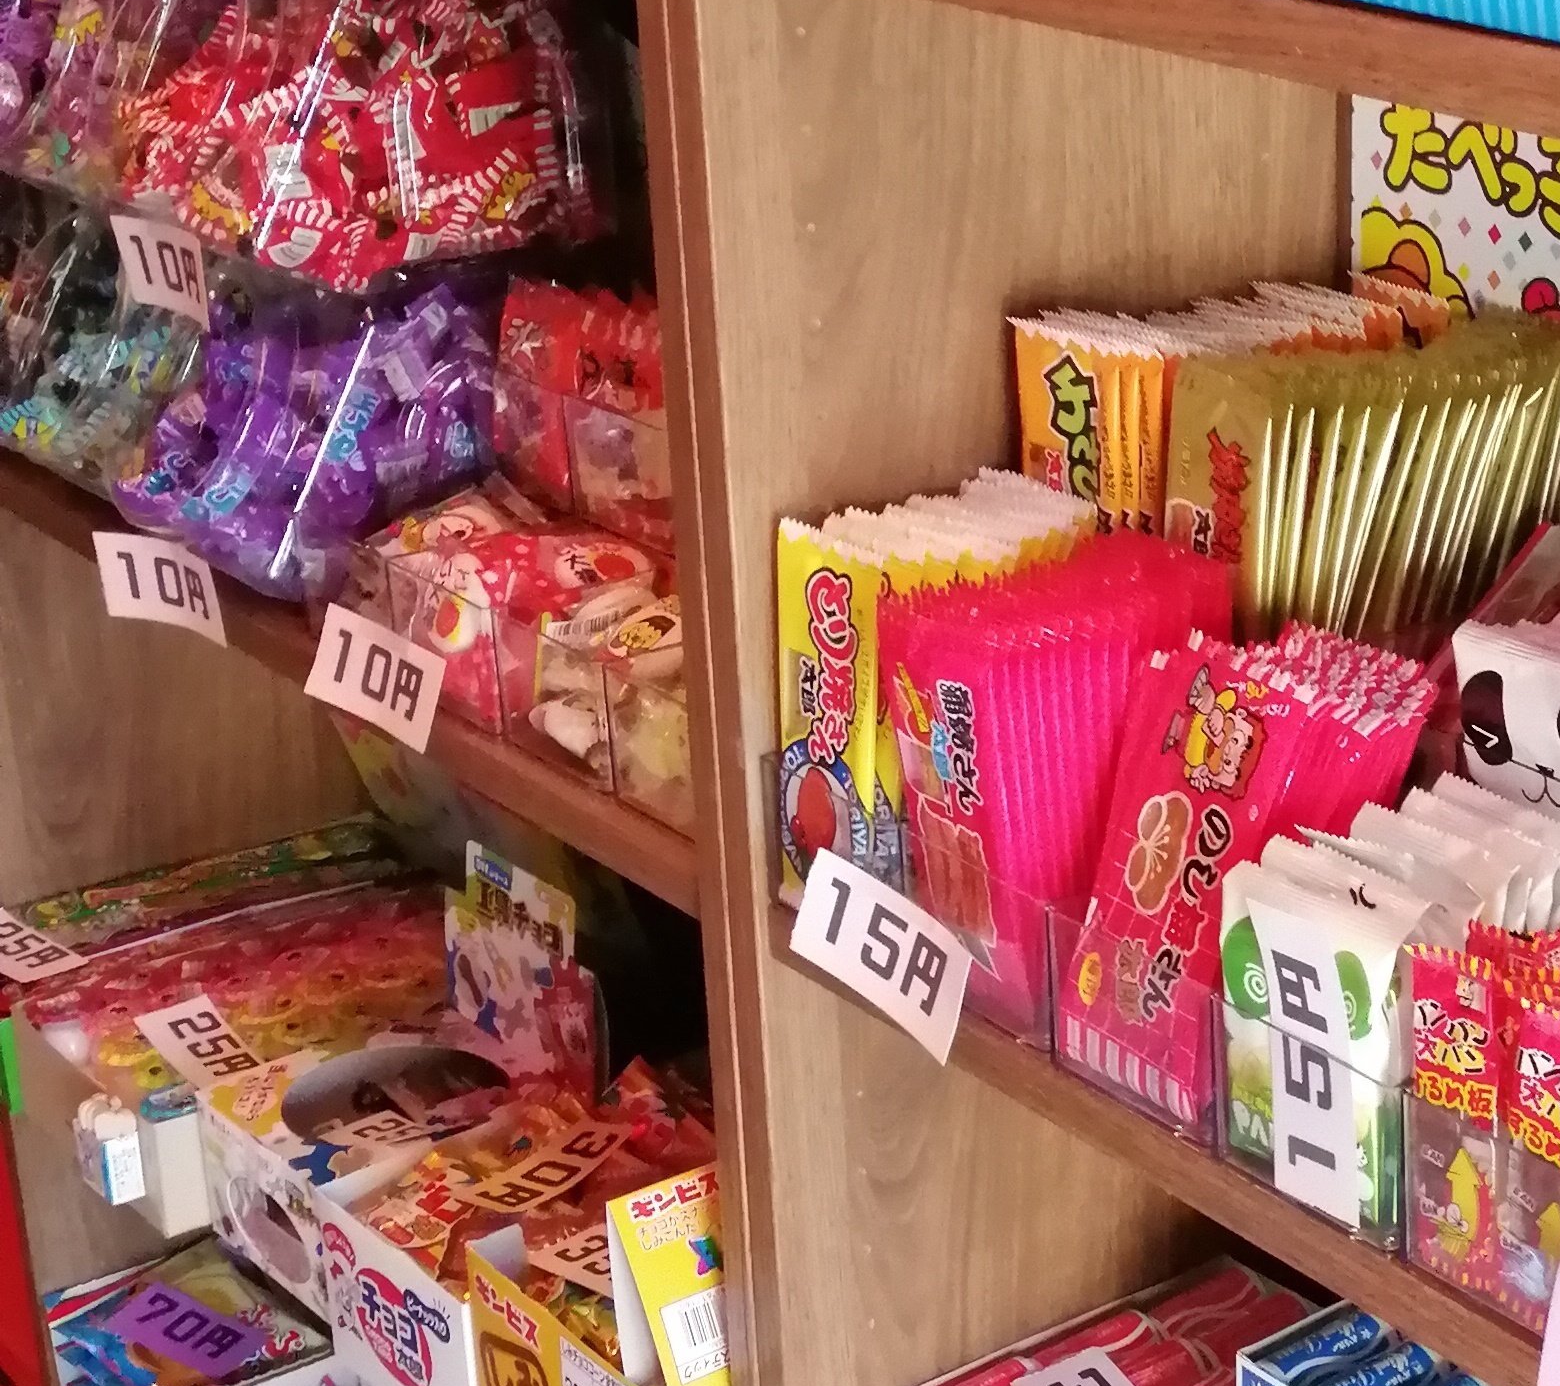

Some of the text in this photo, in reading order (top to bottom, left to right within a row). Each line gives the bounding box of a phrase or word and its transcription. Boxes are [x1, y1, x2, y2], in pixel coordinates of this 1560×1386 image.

[117, 550, 210, 622] 10円
[333, 629, 424, 721] 10円
[823, 875, 950, 1017] 15円
[168, 1011, 262, 1078] 25円
[1273, 949, 1336, 1169] 15円
[483, 1130, 612, 1213] 30円
[146, 1294, 247, 1359] 70円
[362, 1281, 420, 1355] チョコ
[474, 1274, 541, 1348] ギンビス
